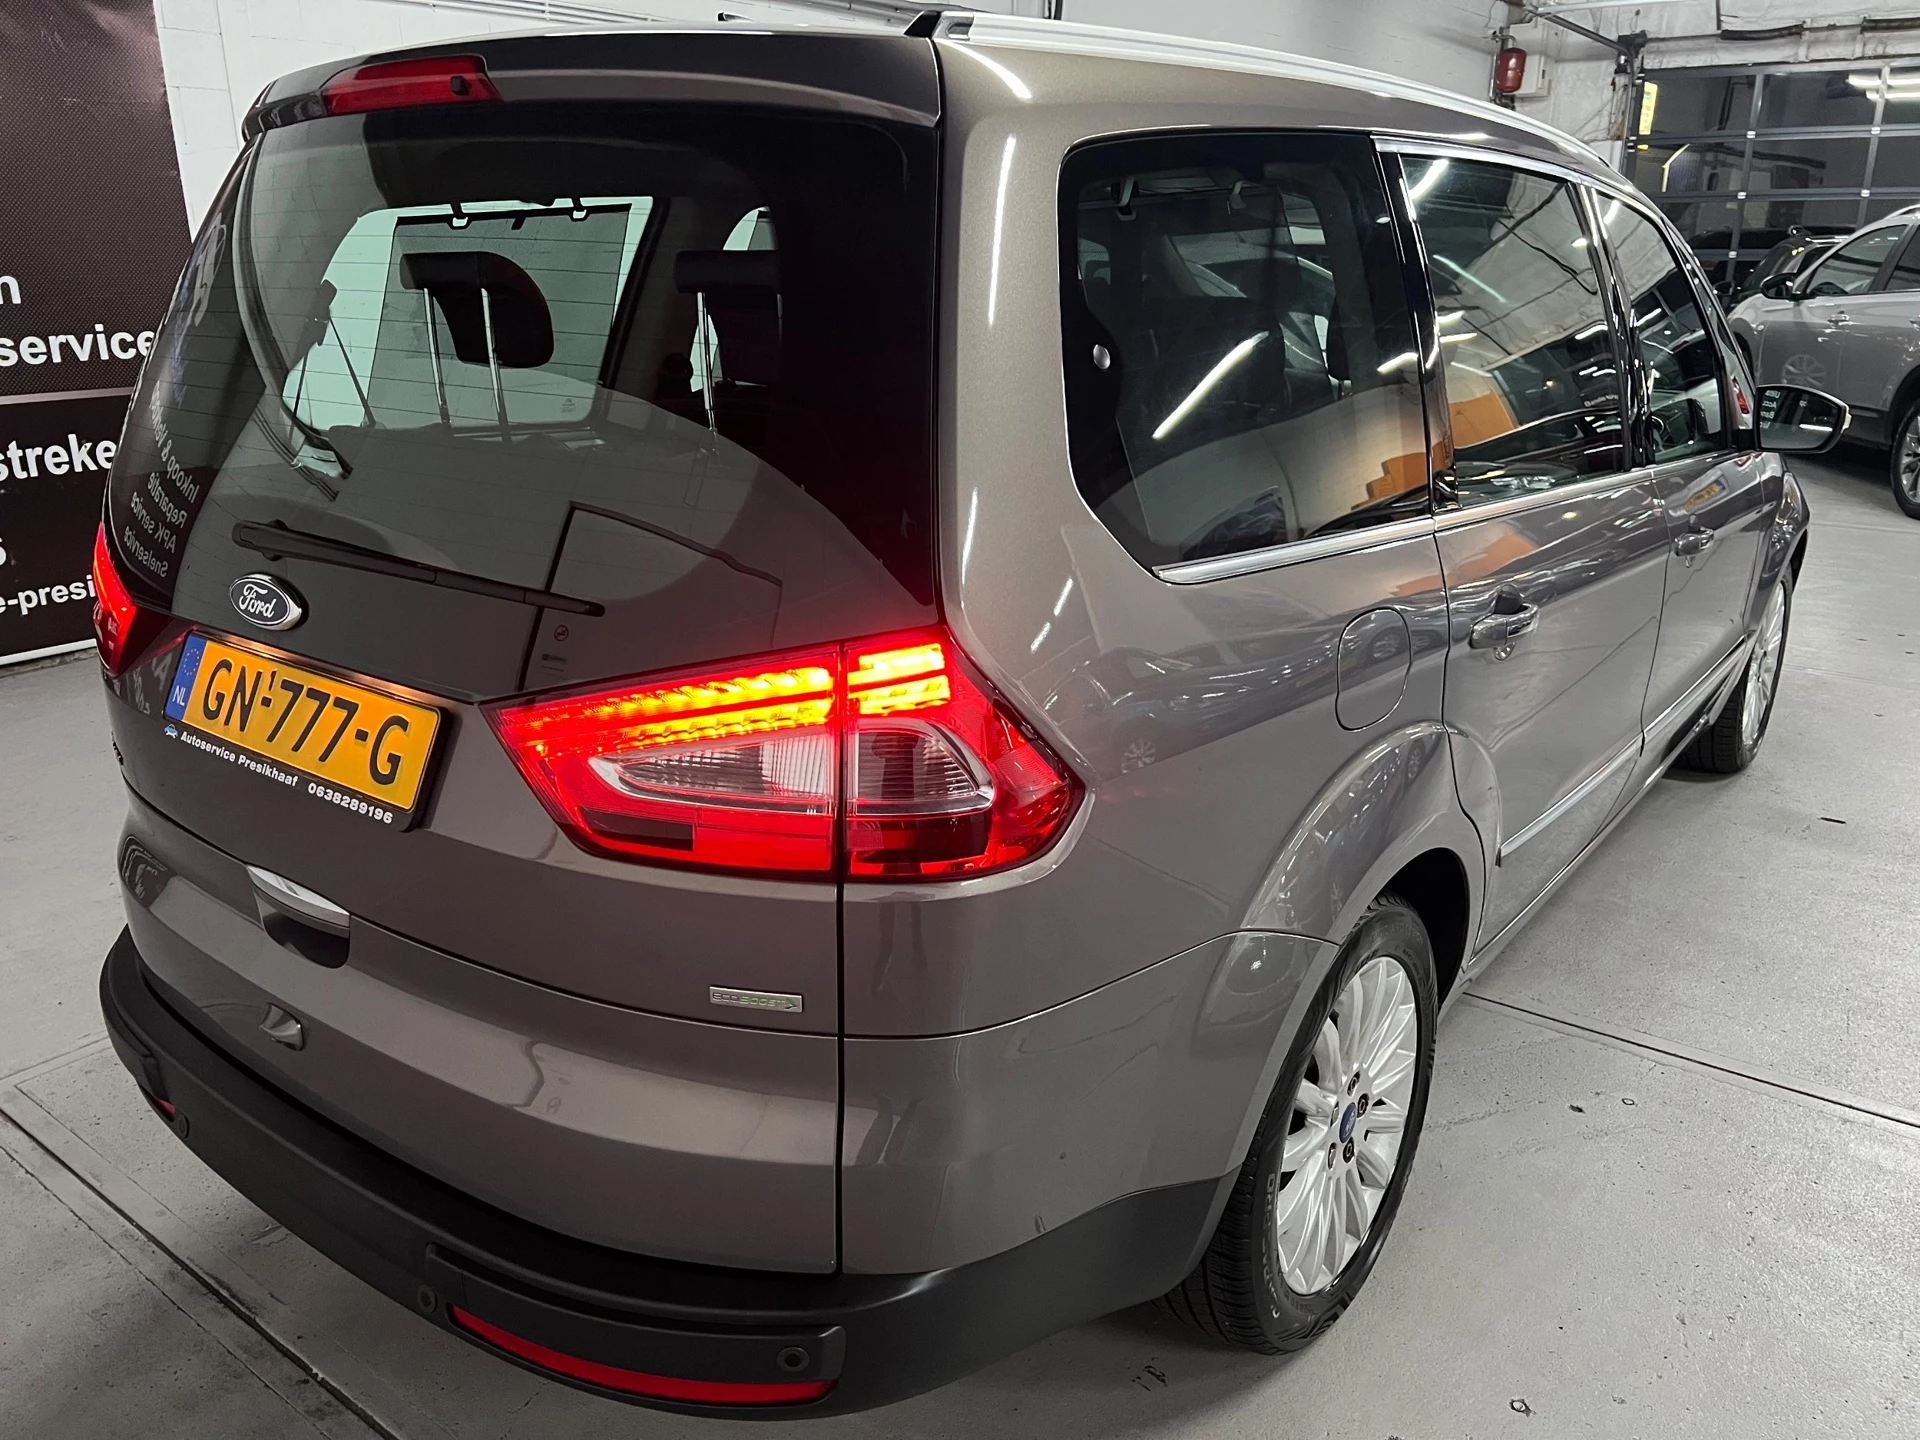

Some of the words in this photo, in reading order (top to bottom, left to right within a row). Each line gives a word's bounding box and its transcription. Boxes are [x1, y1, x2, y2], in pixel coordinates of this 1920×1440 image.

[239, 584, 276, 618] Ford
[172, 685, 187, 706] NL
[202, 658, 410, 785] GN-777-G
[180, 731, 236, 762] Autoservice
[238, 754, 298, 787] Presikhaaf
[307, 782, 394, 824] 0638289196
